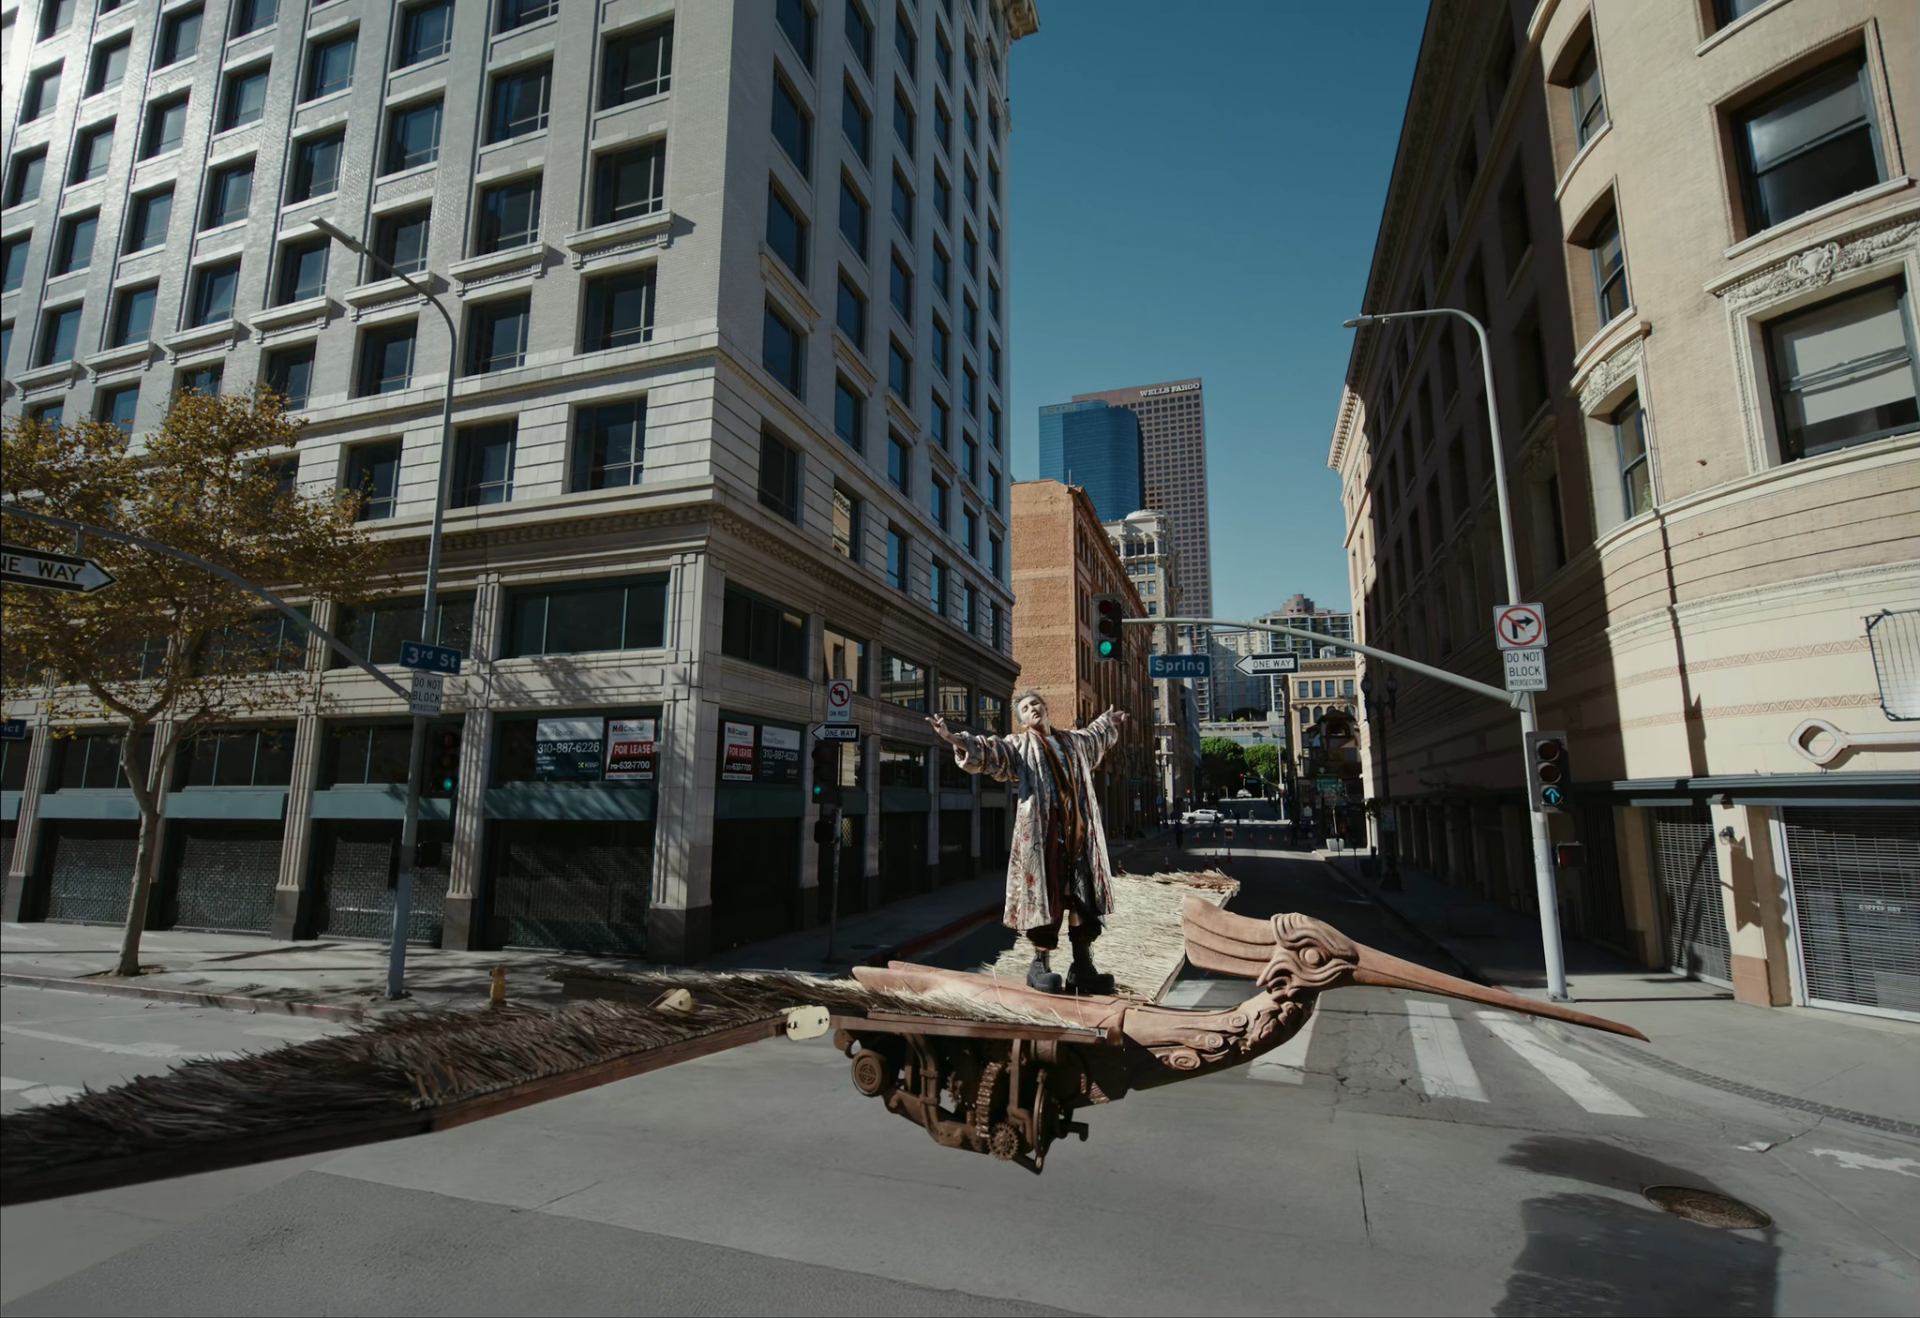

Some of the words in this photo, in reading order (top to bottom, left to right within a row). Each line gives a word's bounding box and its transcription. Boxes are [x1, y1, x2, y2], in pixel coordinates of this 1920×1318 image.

[1139, 387, 1170, 397] WELLS
[1171, 383, 1200, 393] FARGO
[37, 561, 82, 582] WAY
[406, 646, 434, 664] 3rd
[439, 653, 457, 668] St
[1507, 652, 1519, 663] DO
[1523, 652, 1540, 662] NOT
[1155, 659, 1206, 674] Spring
[1252, 660, 1270, 669] ONE
[1272, 659, 1292, 668] WAY
[1509, 666, 1541, 677] BLOCK
[414, 677, 425, 688] DO
[427, 678, 441, 690] NOT
[1509, 679, 1543, 687] INTERSECTION
[412, 691, 440, 703] BLOCK
[412, 703, 439, 712] INTERSECTION
[537, 742, 600, 754] 310-887-6226
[614, 745, 627, 754] FOR
[629, 744, 651, 754] LEASE
[729, 747, 738, 756] FOR
[739, 747, 752, 758] LEASE
